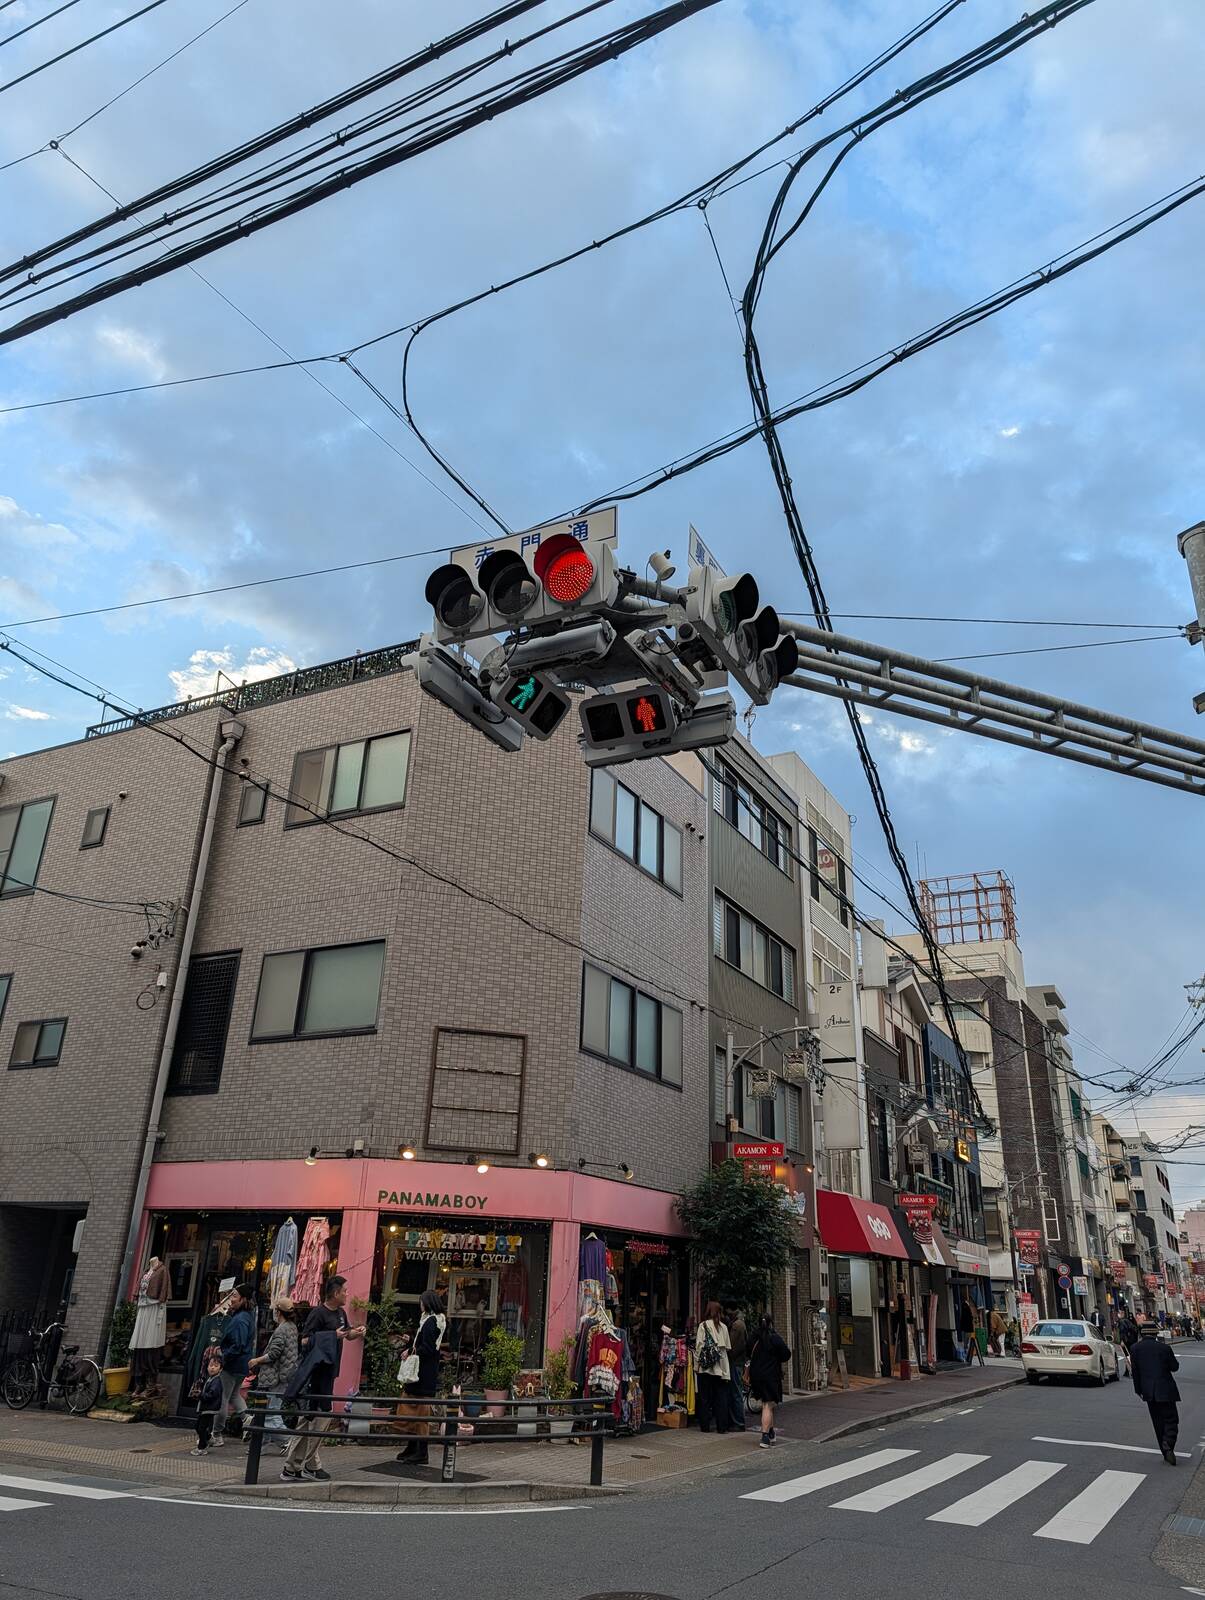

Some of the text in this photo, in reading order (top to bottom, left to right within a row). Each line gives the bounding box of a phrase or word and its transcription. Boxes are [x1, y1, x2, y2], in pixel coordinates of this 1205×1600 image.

[829, 985, 842, 994] 2F
[378, 1190, 488, 1209] PANAMABOY
[408, 1230, 519, 1253] PANAMA BOY
[404, 1251, 453, 1262] VINTAGE
[462, 1252, 477, 1261] UP
[480, 1253, 516, 1264] CYCLE
